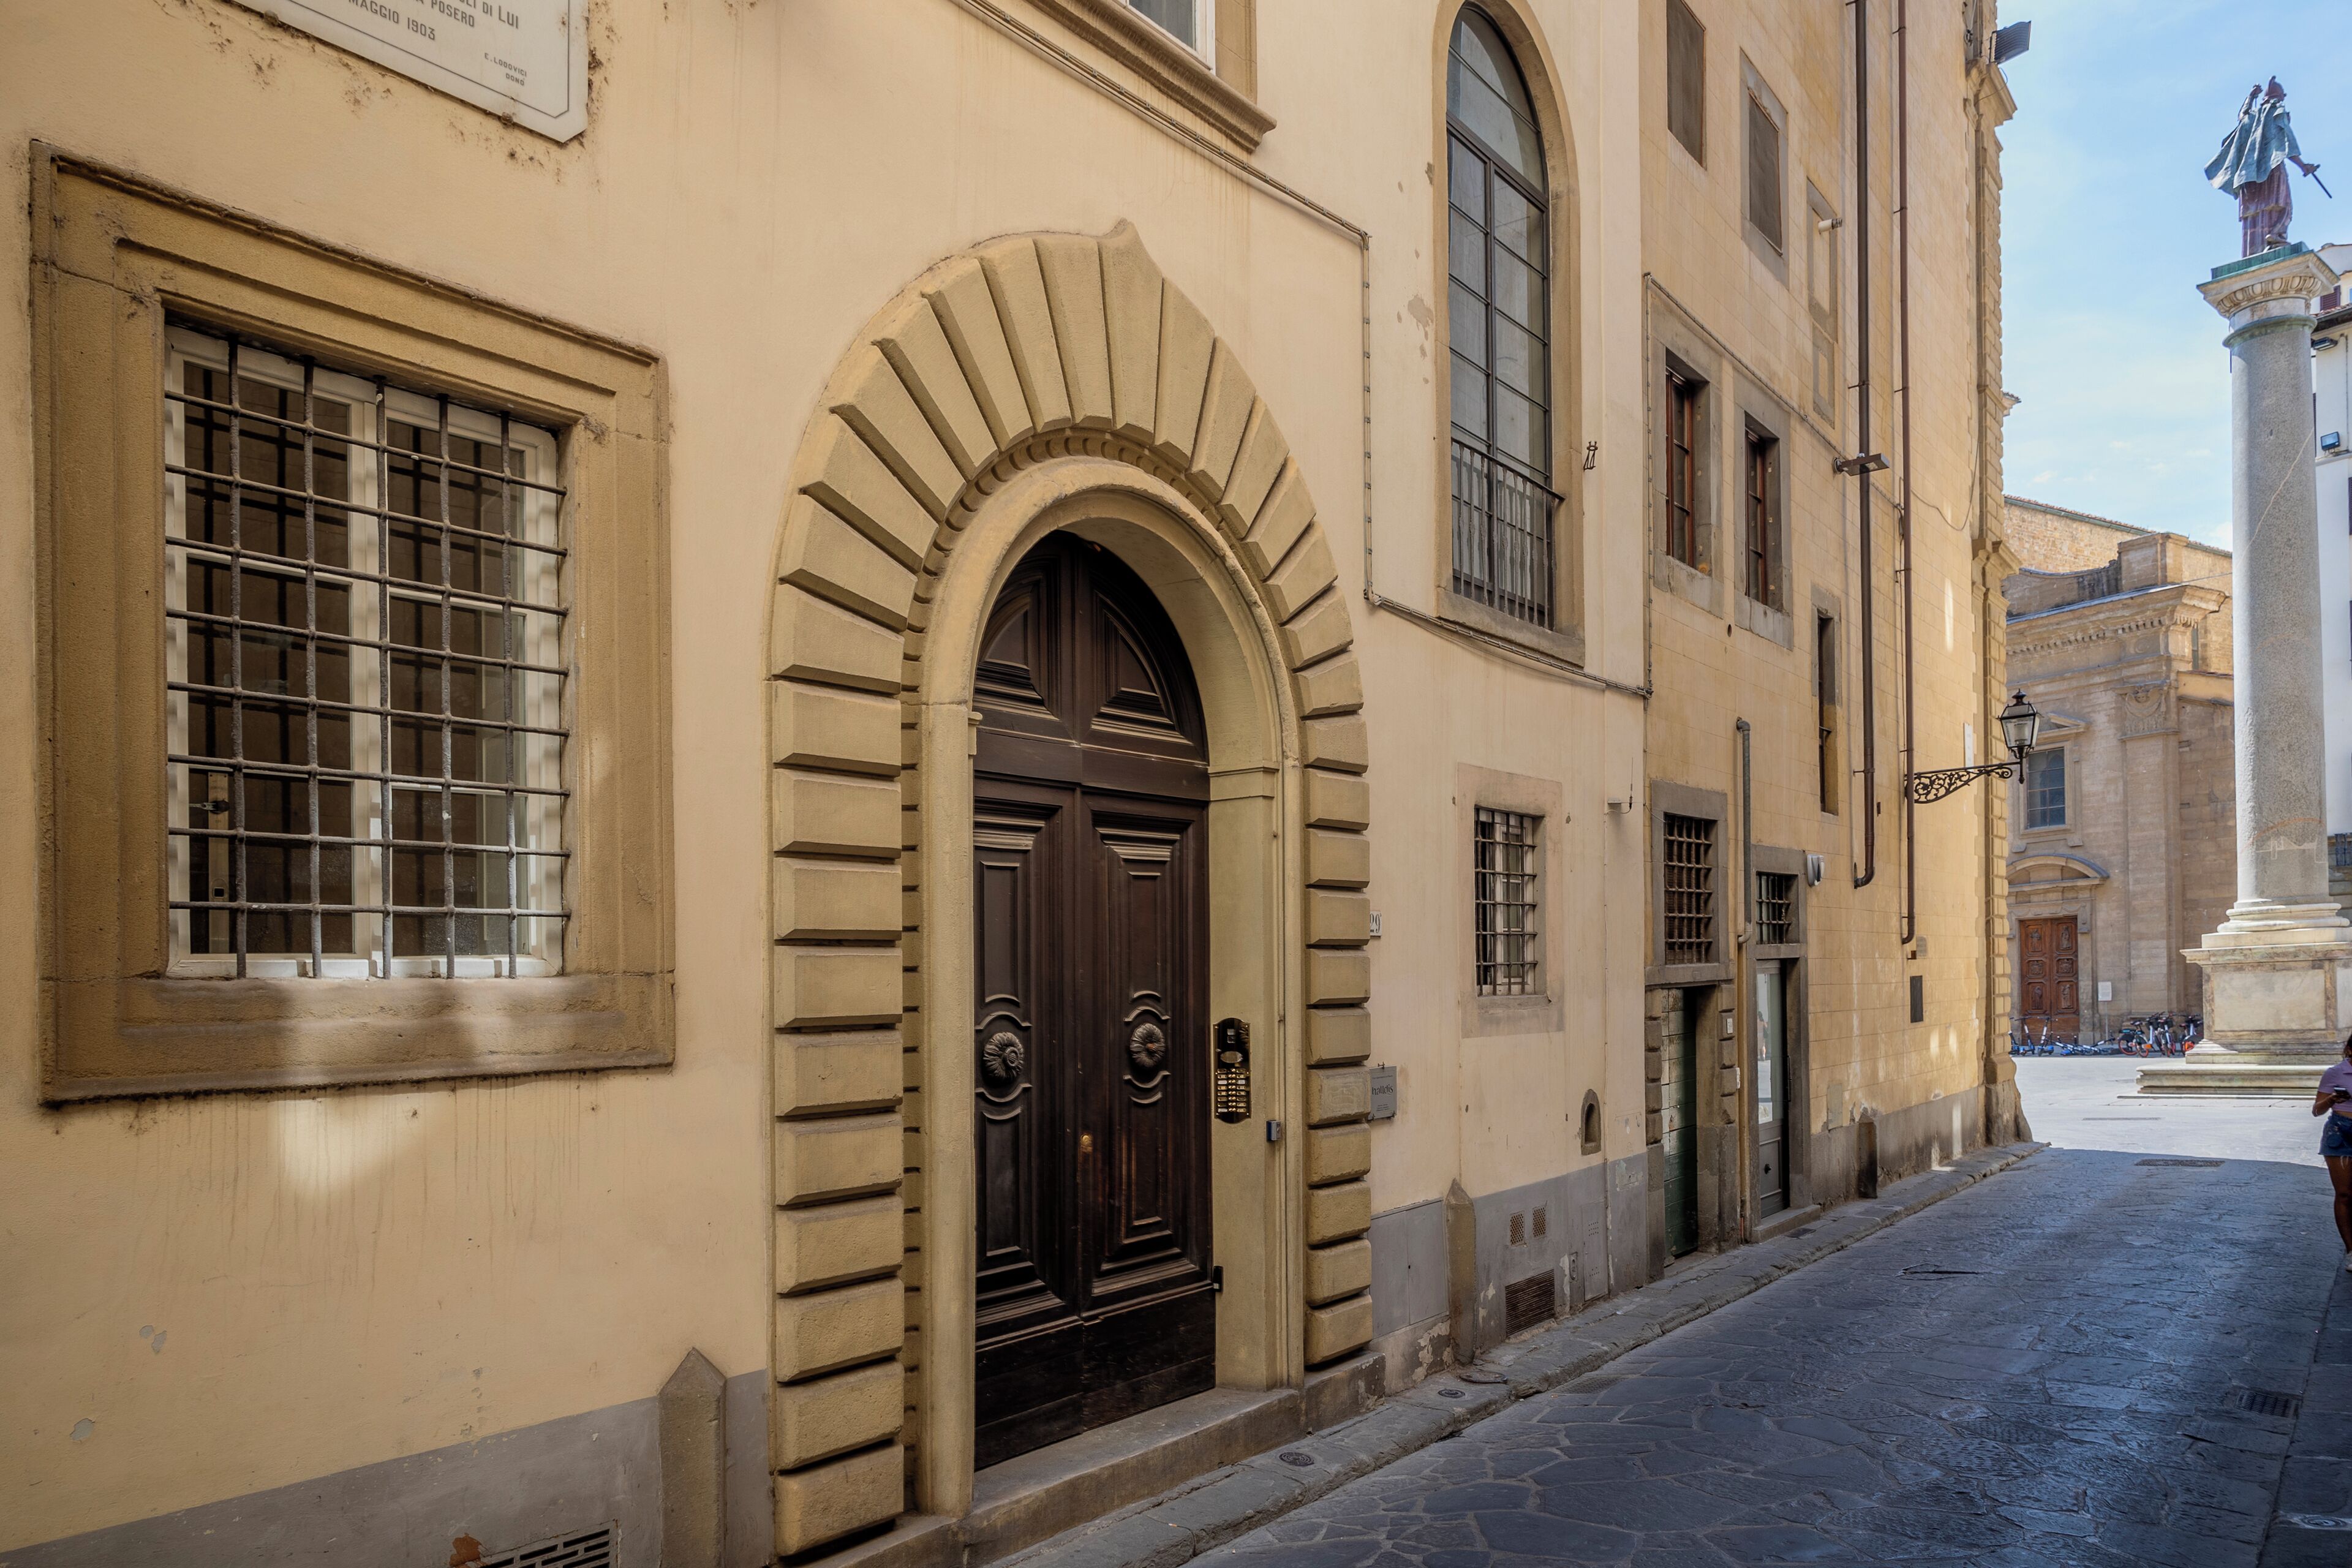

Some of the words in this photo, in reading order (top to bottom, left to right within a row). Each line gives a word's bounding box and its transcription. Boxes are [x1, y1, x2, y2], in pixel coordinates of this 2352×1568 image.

[431, 0, 475, 28] POSERO
[483, 1, 492, 17] DI
[407, 17, 435, 40] 1903
